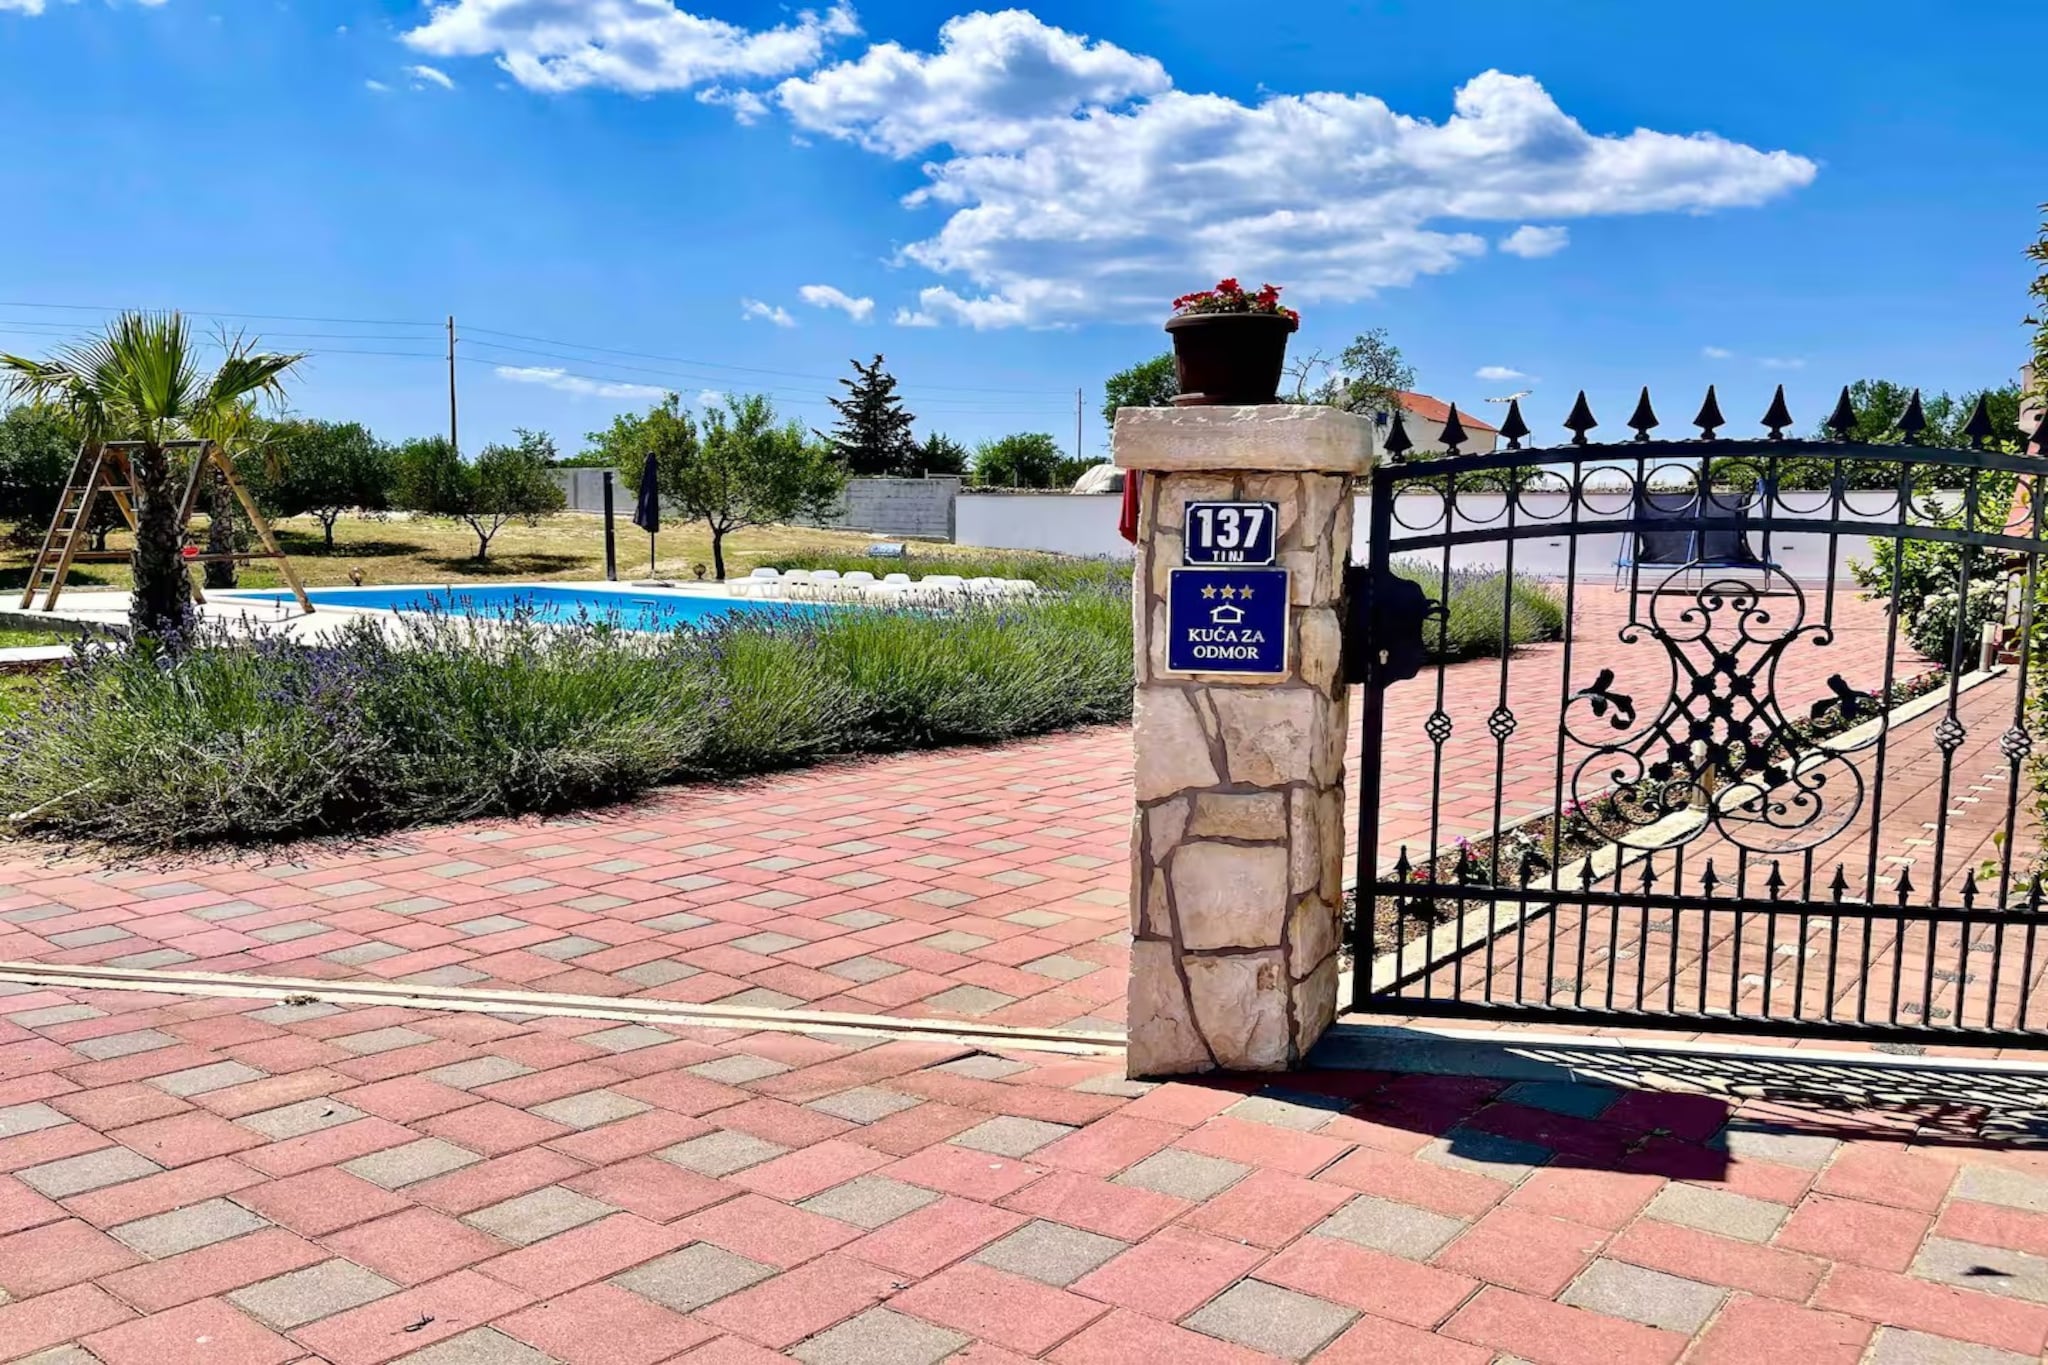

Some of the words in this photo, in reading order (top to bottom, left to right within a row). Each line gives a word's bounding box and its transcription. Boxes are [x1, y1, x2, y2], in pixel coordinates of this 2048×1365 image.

[1197, 508, 1264, 548] 137
[1212, 550, 1245, 562] TINJ
[1188, 626, 1238, 642] KUĆA
[1241, 629, 1265, 643] ZA
[1193, 645, 1259, 660] ODMOR
